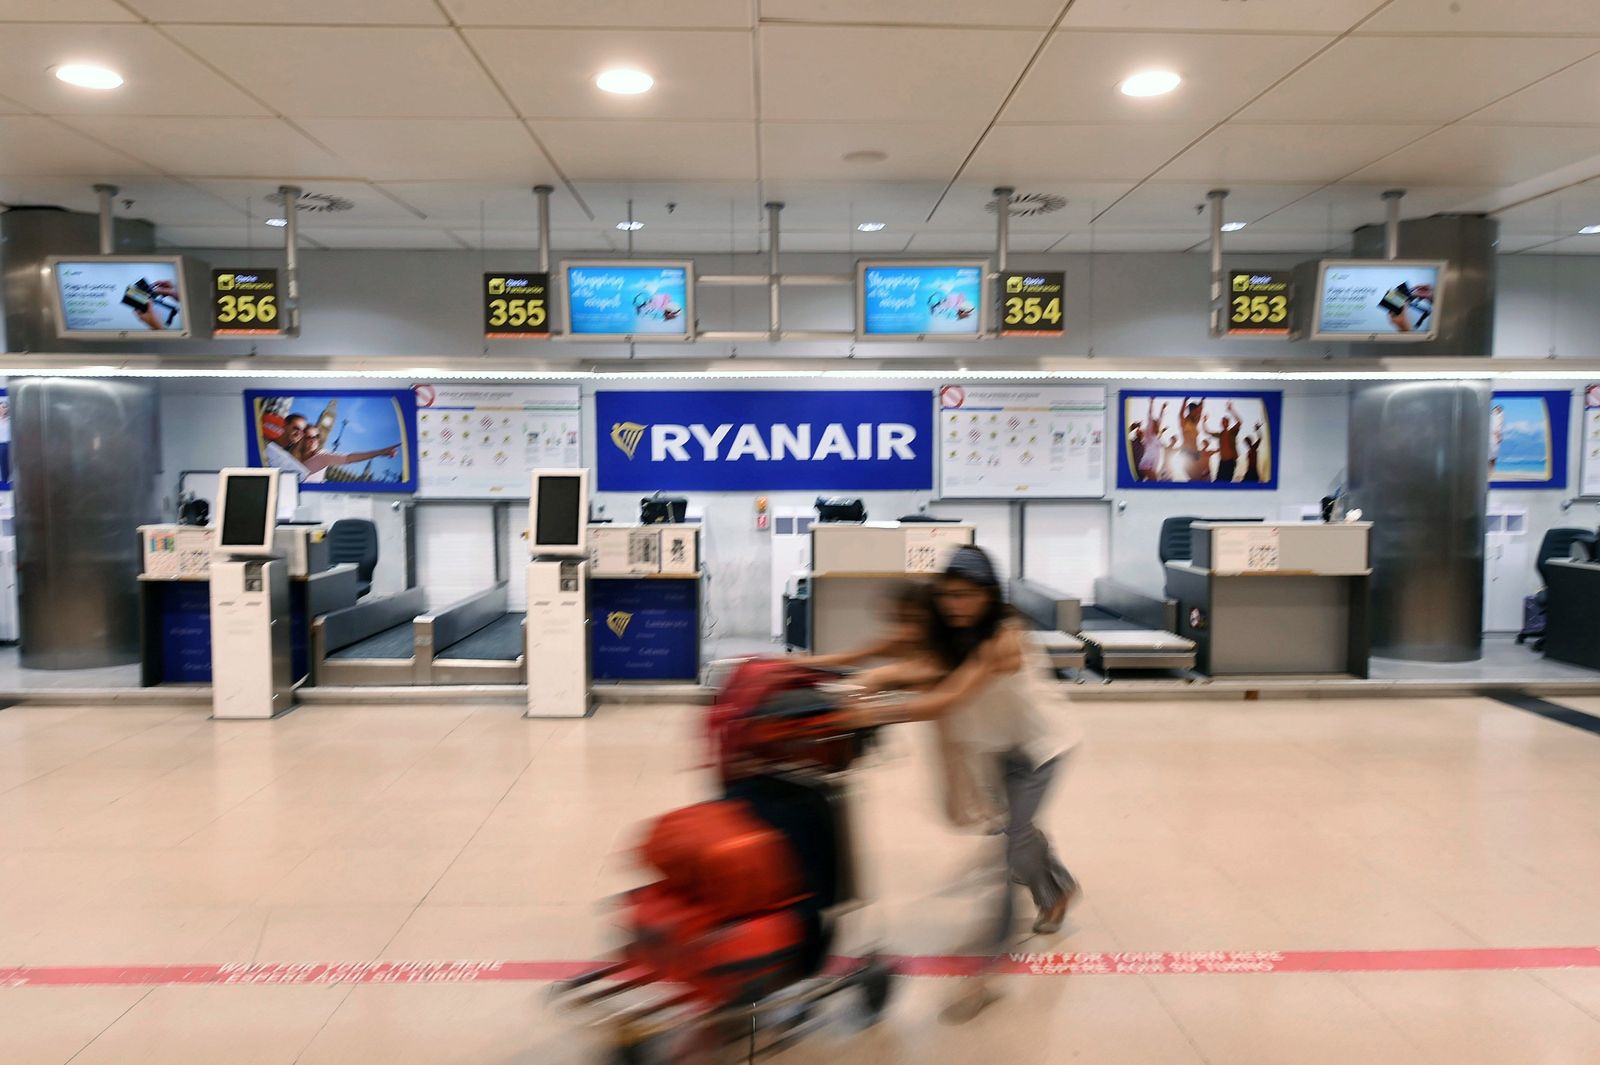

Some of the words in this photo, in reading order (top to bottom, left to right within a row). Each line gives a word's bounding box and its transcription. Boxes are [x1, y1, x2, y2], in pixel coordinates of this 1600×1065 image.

[217, 295, 277, 323] 356
[489, 299, 546, 327] 355
[1004, 297, 1062, 325] 354
[1231, 295, 1288, 323] 353
[651, 423, 917, 461] RYANAIR
[216, 962, 271, 974] WAIT
[273, 961, 317, 973] FOR
[325, 961, 384, 973] YOUR
[1009, 953, 1056, 964] WAIT
[1061, 952, 1104, 963] FOR
[1111, 952, 1164, 963] YOUR
